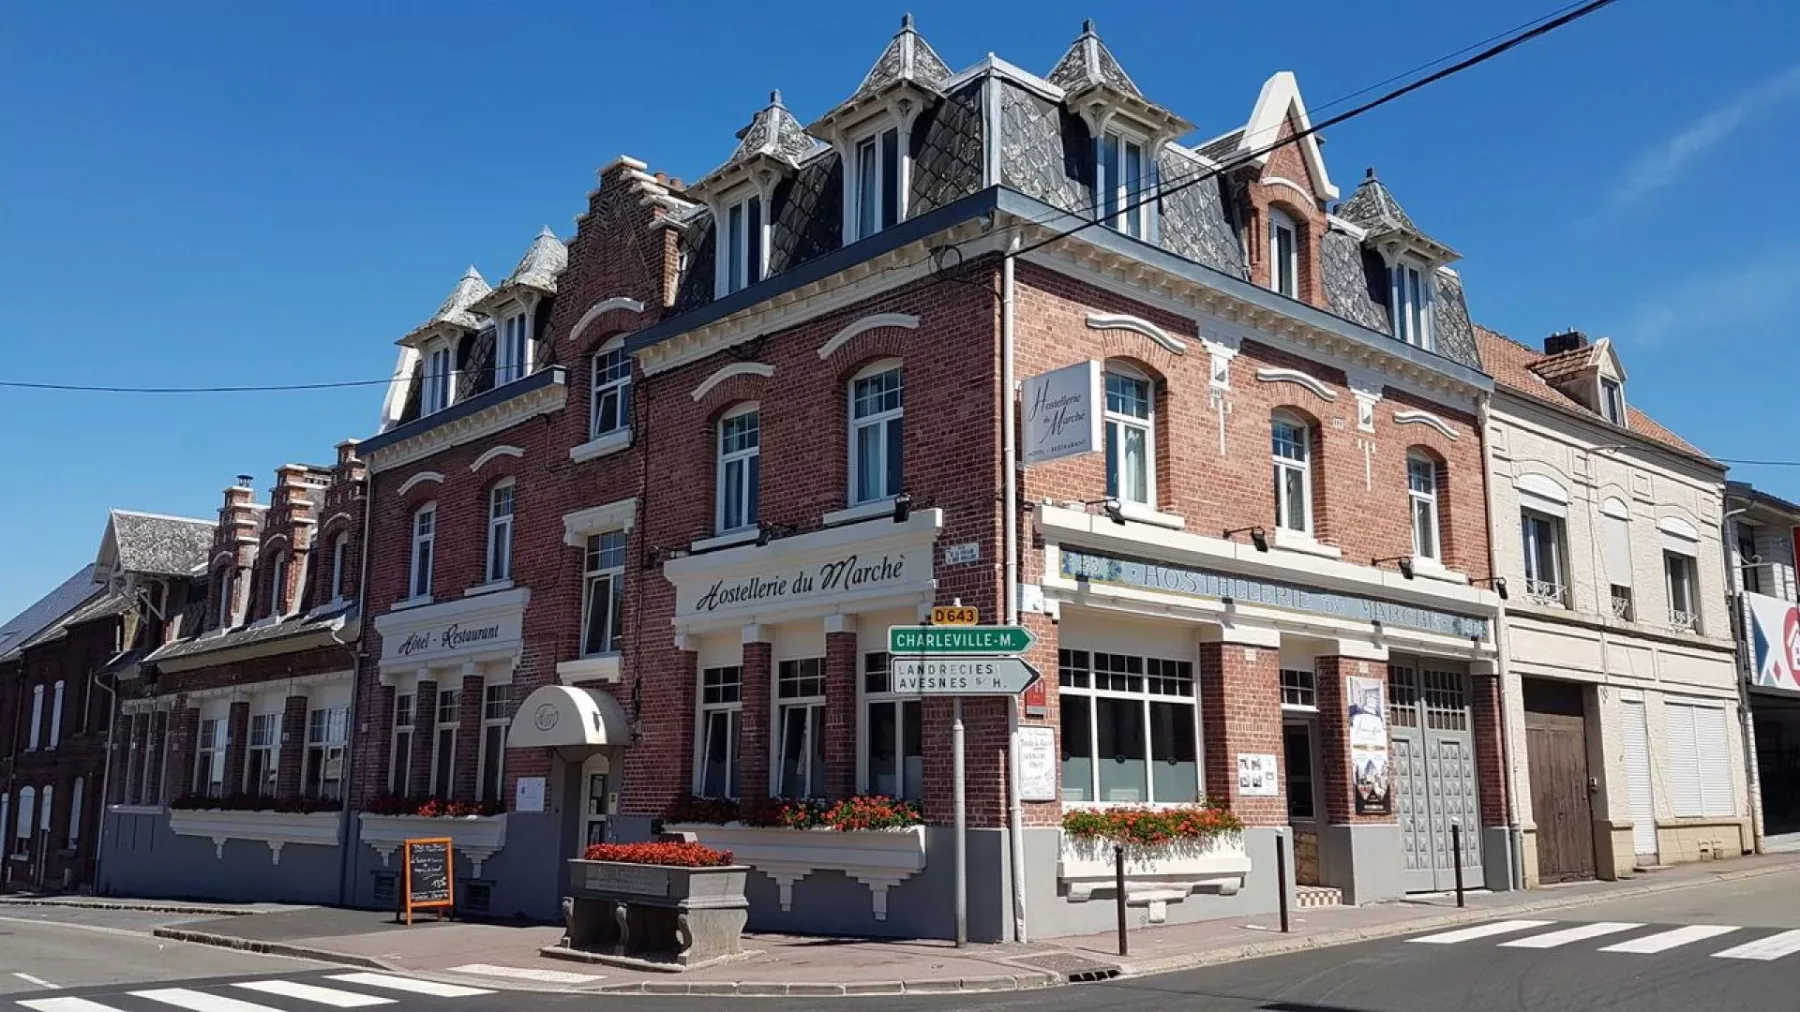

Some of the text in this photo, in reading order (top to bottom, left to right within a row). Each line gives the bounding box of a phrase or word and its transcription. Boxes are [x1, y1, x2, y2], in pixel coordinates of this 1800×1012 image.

[696, 575, 787, 611] Hostellerie
[792, 571, 813, 594] du
[935, 609, 975, 622] D 643
[441, 624, 499, 649] Restaurant
[896, 633, 1016, 647] CHARLEVILLE-M.
[899, 664, 994, 675] LANDRECIES
[899, 677, 968, 688] AVESNES
[992, 677, 1007, 688] H.
